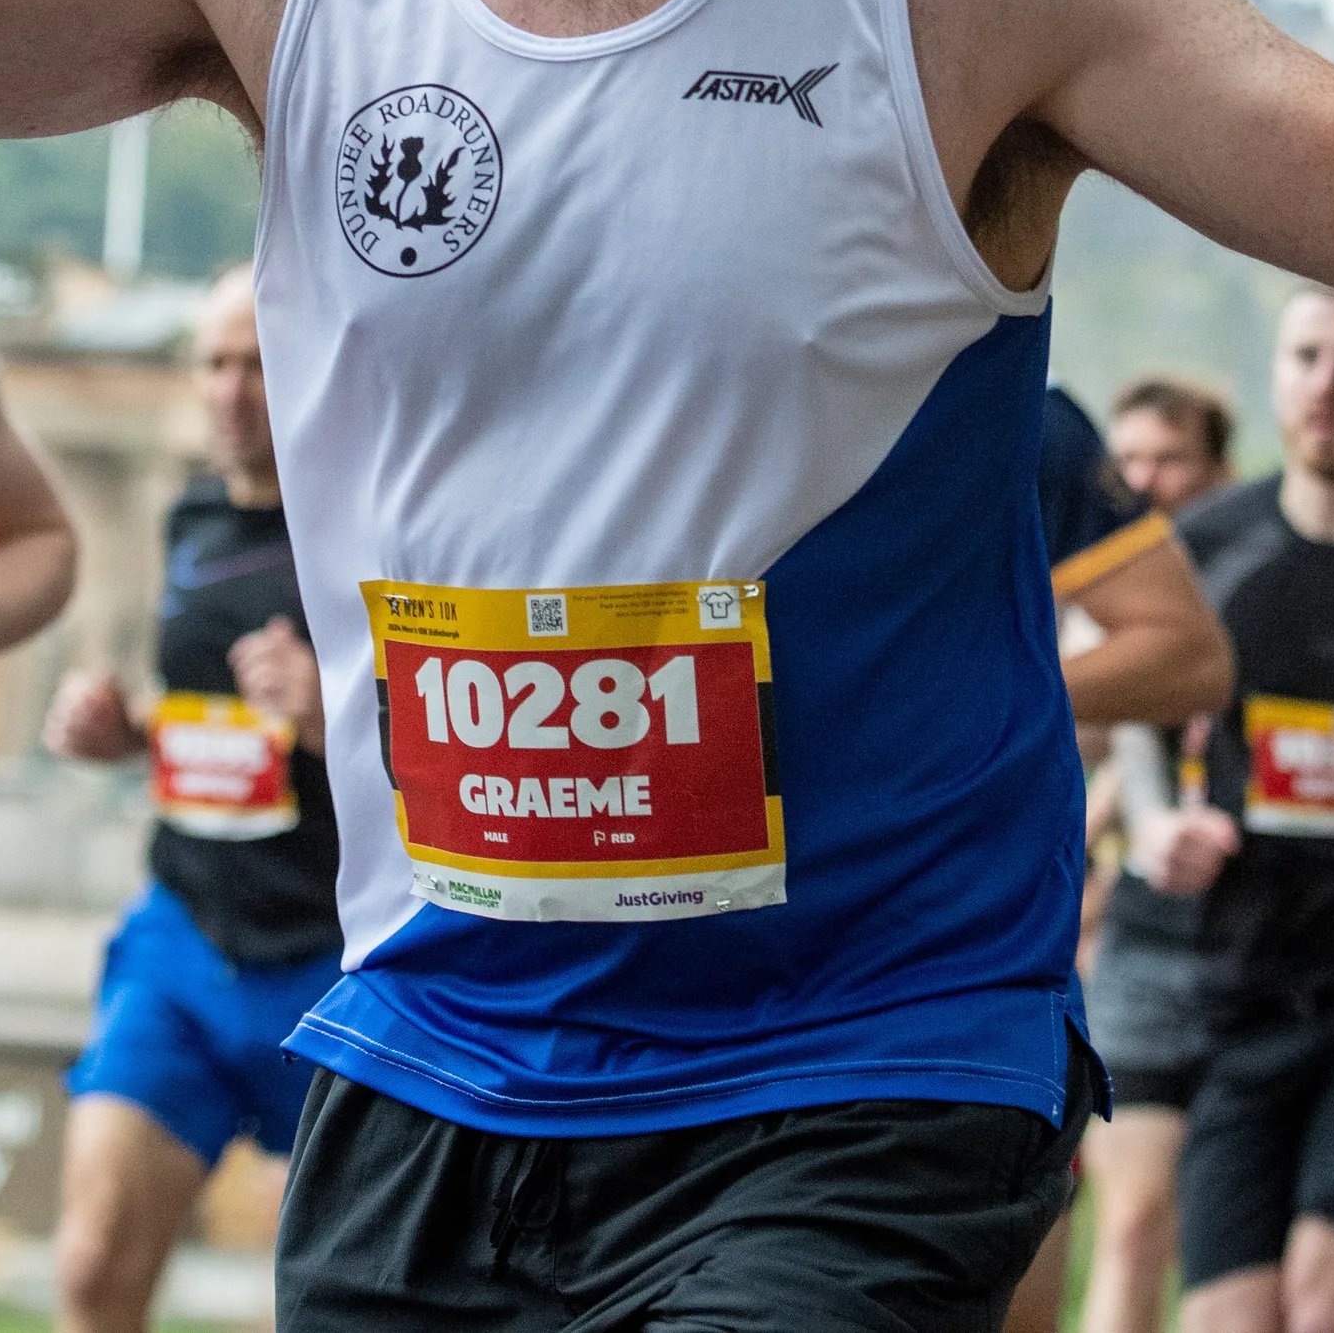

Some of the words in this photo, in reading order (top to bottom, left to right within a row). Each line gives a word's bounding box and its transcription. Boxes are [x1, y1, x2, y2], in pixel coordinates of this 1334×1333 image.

[339, 123, 380, 256] DUNDEE
[378, 92, 494, 253] ROADRUNNERS
[404, 598, 434, 619] MEN'S
[439, 602, 458, 621] 10K
[415, 655, 701, 750] 10281
[459, 774, 652, 818] GRAEME
[483, 831, 509, 843] MALE
[610, 832, 636, 844] RED
[449, 881, 501, 900] MACMILLAN
[614, 890, 705, 907] JustGiving
